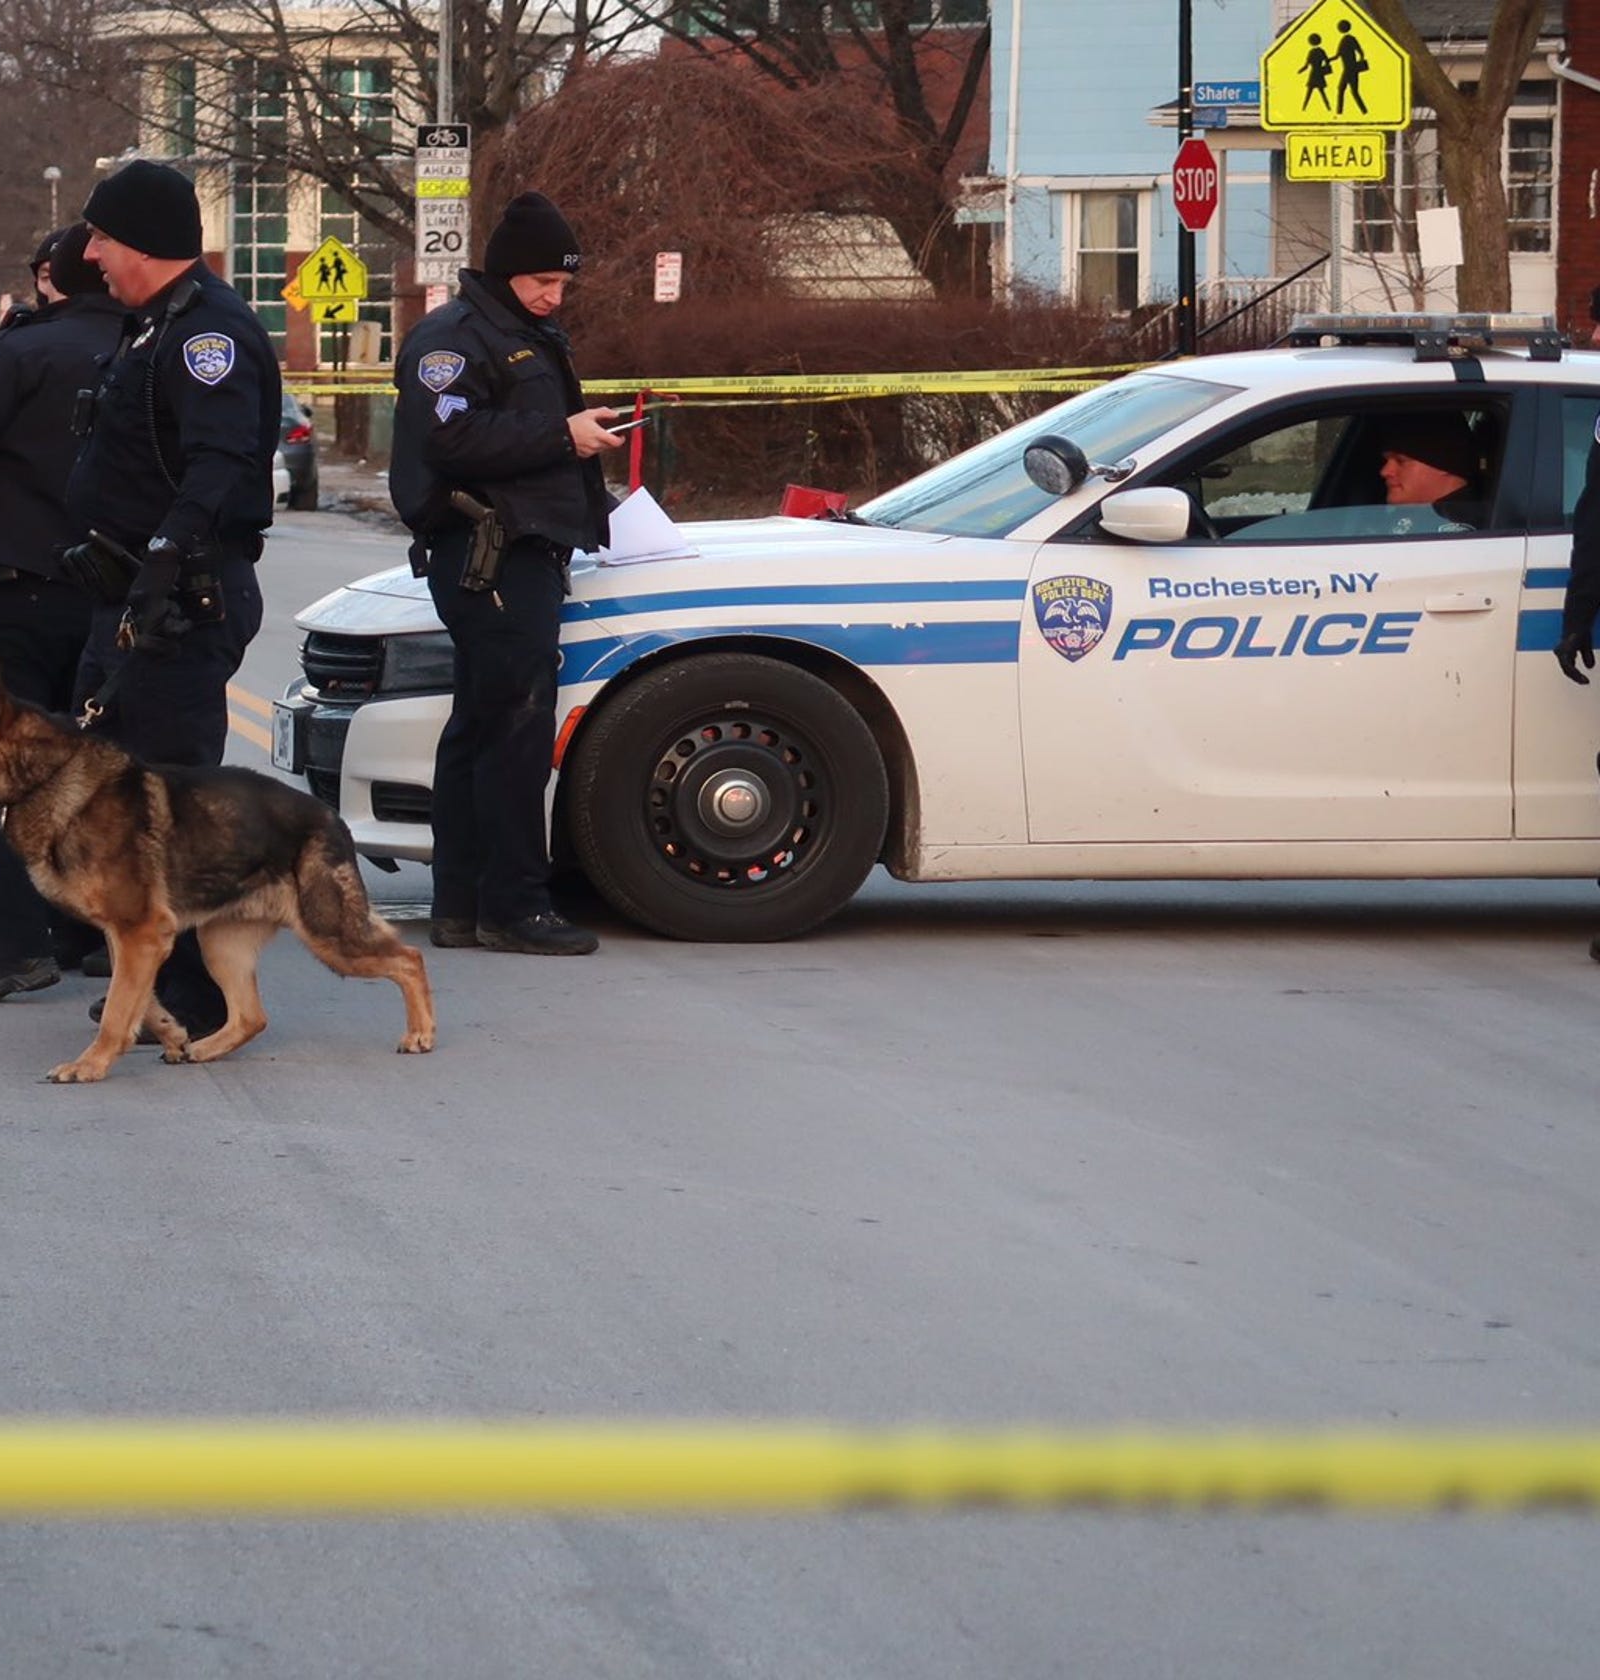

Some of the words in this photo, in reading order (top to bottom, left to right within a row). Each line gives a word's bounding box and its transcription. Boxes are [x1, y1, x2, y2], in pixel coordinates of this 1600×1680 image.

[1196, 85, 1241, 101] Shafer
[442, 150, 467, 160] LANE
[1298, 145, 1373, 167] AHEAD
[423, 166, 464, 176] AHEAD
[421, 181, 466, 193] SCHOOL
[1175, 167, 1216, 201] STOP
[422, 203, 464, 214] SPEED
[426, 217, 460, 227] LIMIT
[424, 230, 462, 253] 20
[1148, 576, 1321, 599] Rochester,
[1329, 572, 1380, 594] NY
[1041, 587, 1080, 604] POLICE
[1111, 611, 1423, 661] POLICE
